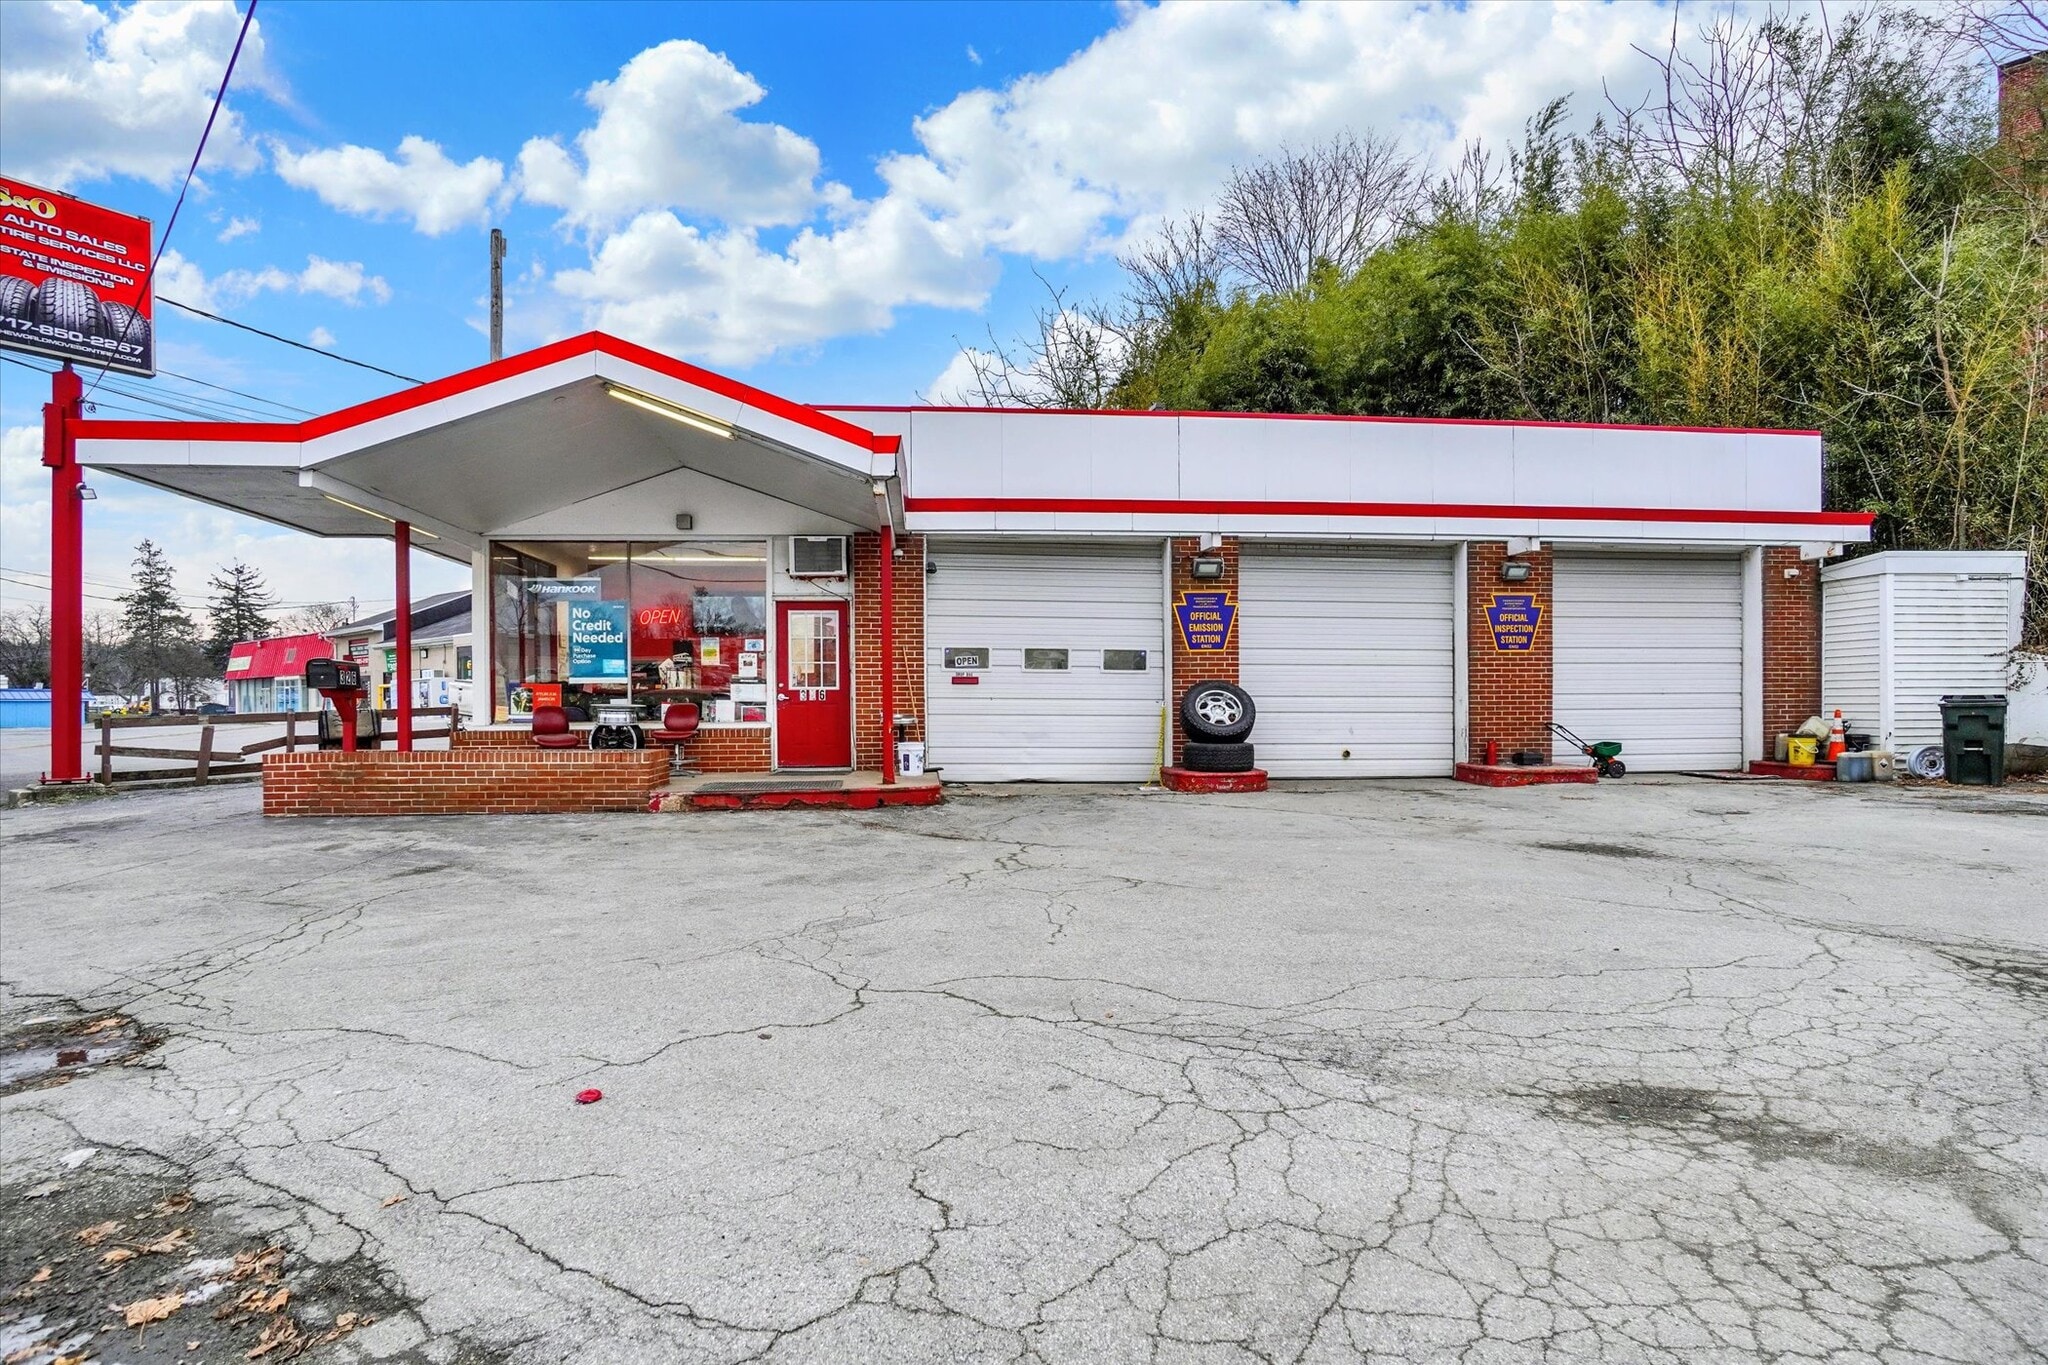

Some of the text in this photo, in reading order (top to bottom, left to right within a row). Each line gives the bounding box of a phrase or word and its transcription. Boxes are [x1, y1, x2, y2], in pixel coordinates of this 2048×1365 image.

[4, 213, 127, 255] AUTO SALES
[0, 225, 146, 272] TIRE SERVICES LLC
[0, 245, 134, 286] STATE INSPECTION
[22, 259, 115, 289] & EMISSIONS
[0, 315, 144, 355] 17-850-2267
[572, 607, 592, 619] No
[639, 608, 682, 625] OPEN
[1190, 611, 1222, 621] OFFICIAL
[1499, 613, 1529, 622] OFFICIAL
[572, 619, 612, 631] Credit
[1188, 623, 1224, 632] EMISSION
[1494, 624, 1534, 633] INSPECTION
[572, 631, 624, 643] Needed
[1191, 634, 1221, 643] STATION
[1500, 635, 1528, 644] STATION
[956, 656, 978, 666] OPEN
